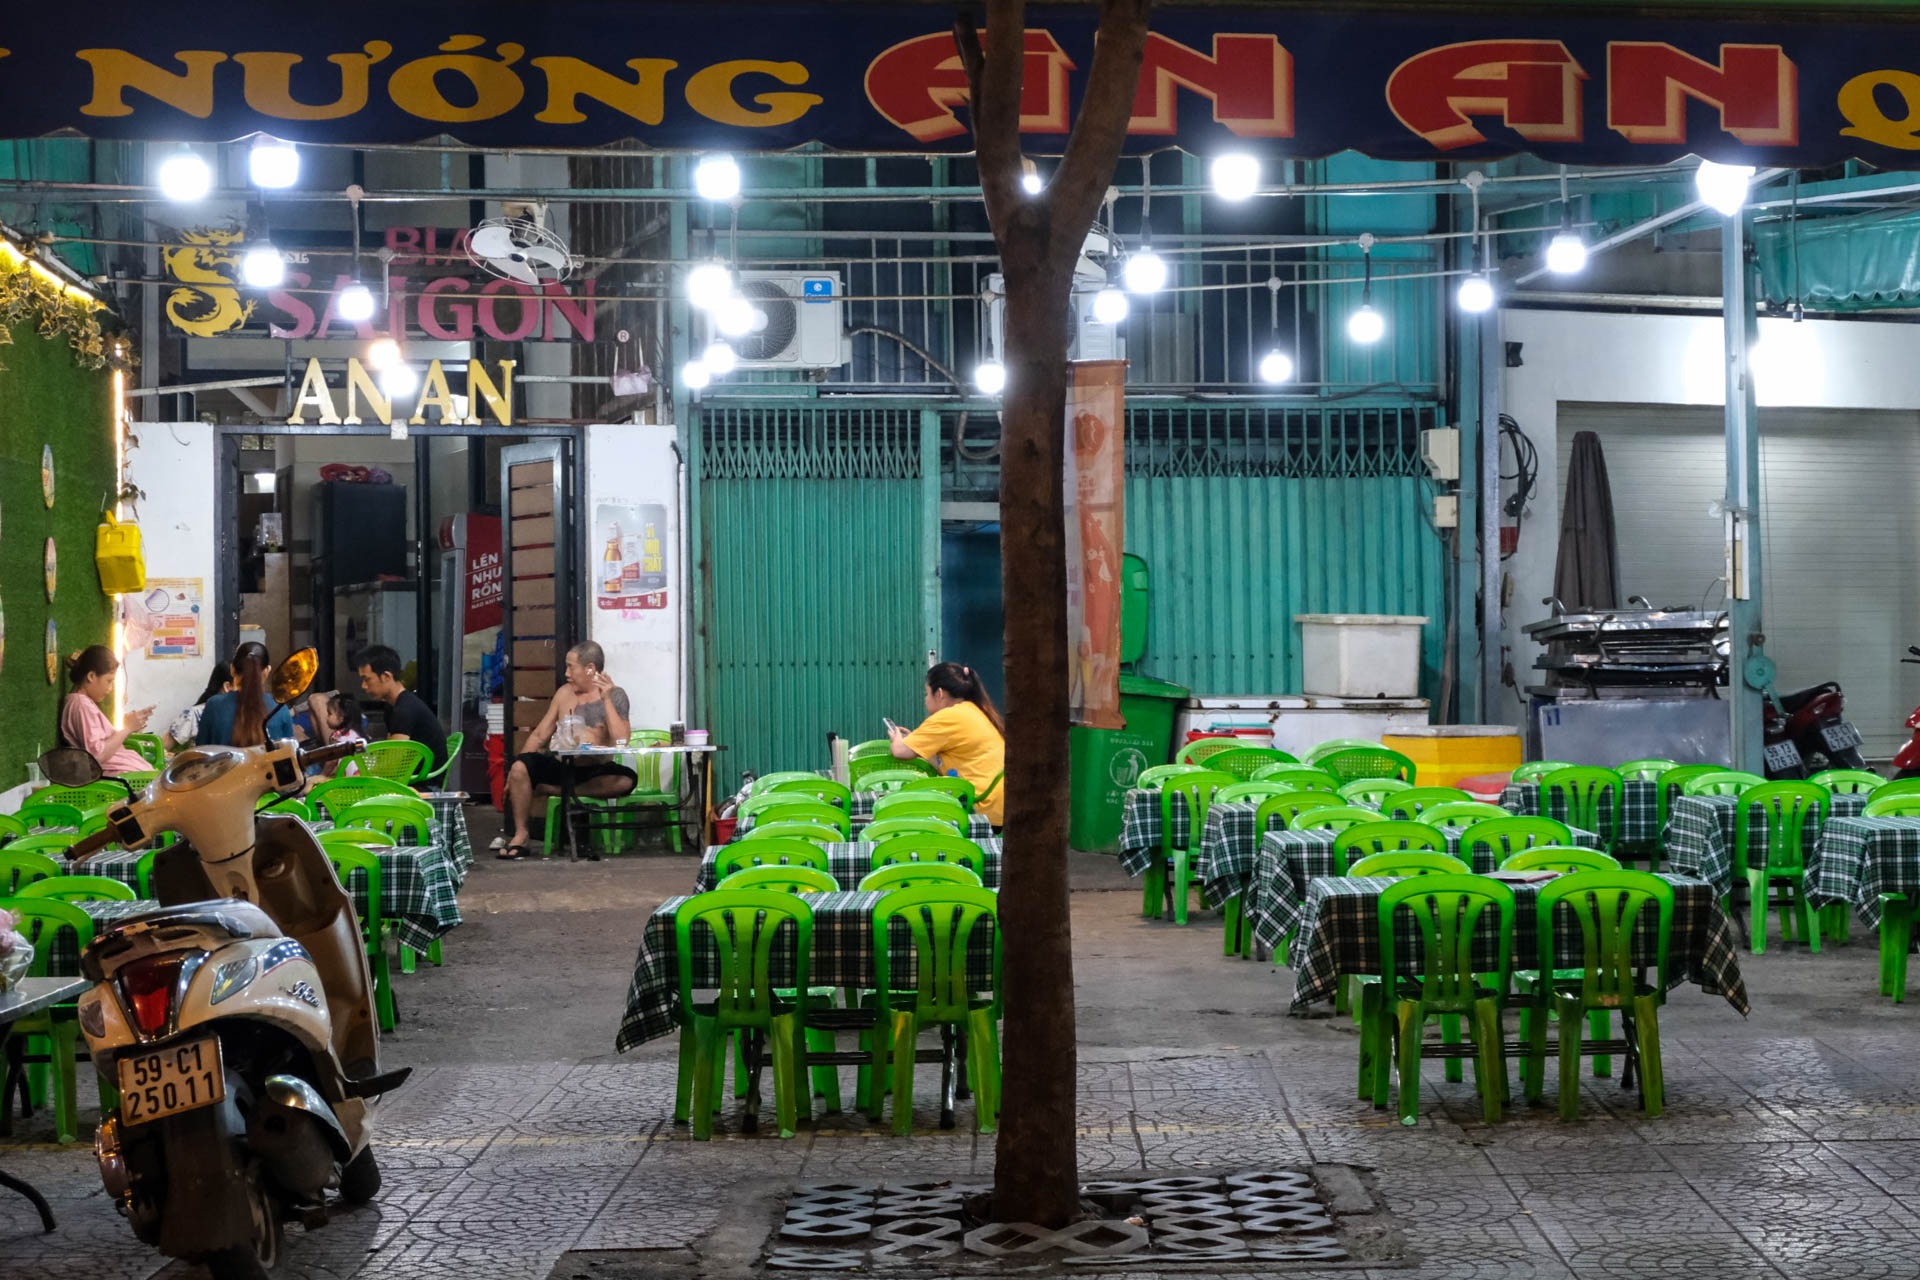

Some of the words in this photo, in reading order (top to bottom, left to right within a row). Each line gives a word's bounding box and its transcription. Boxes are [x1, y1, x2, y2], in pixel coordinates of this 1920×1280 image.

[75, 33, 824, 128] NƯỚNG
[864, 28, 1294, 143] AN
[1385, 38, 1799, 151] AN
[268, 272, 597, 342] SAIGON
[287, 357, 392, 426] AN
[409, 358, 517, 426] AN
[472, 552, 499, 571] LÊN
[133, 1043, 203, 1087] 59-C1
[127, 1070, 215, 1120] 250.11
